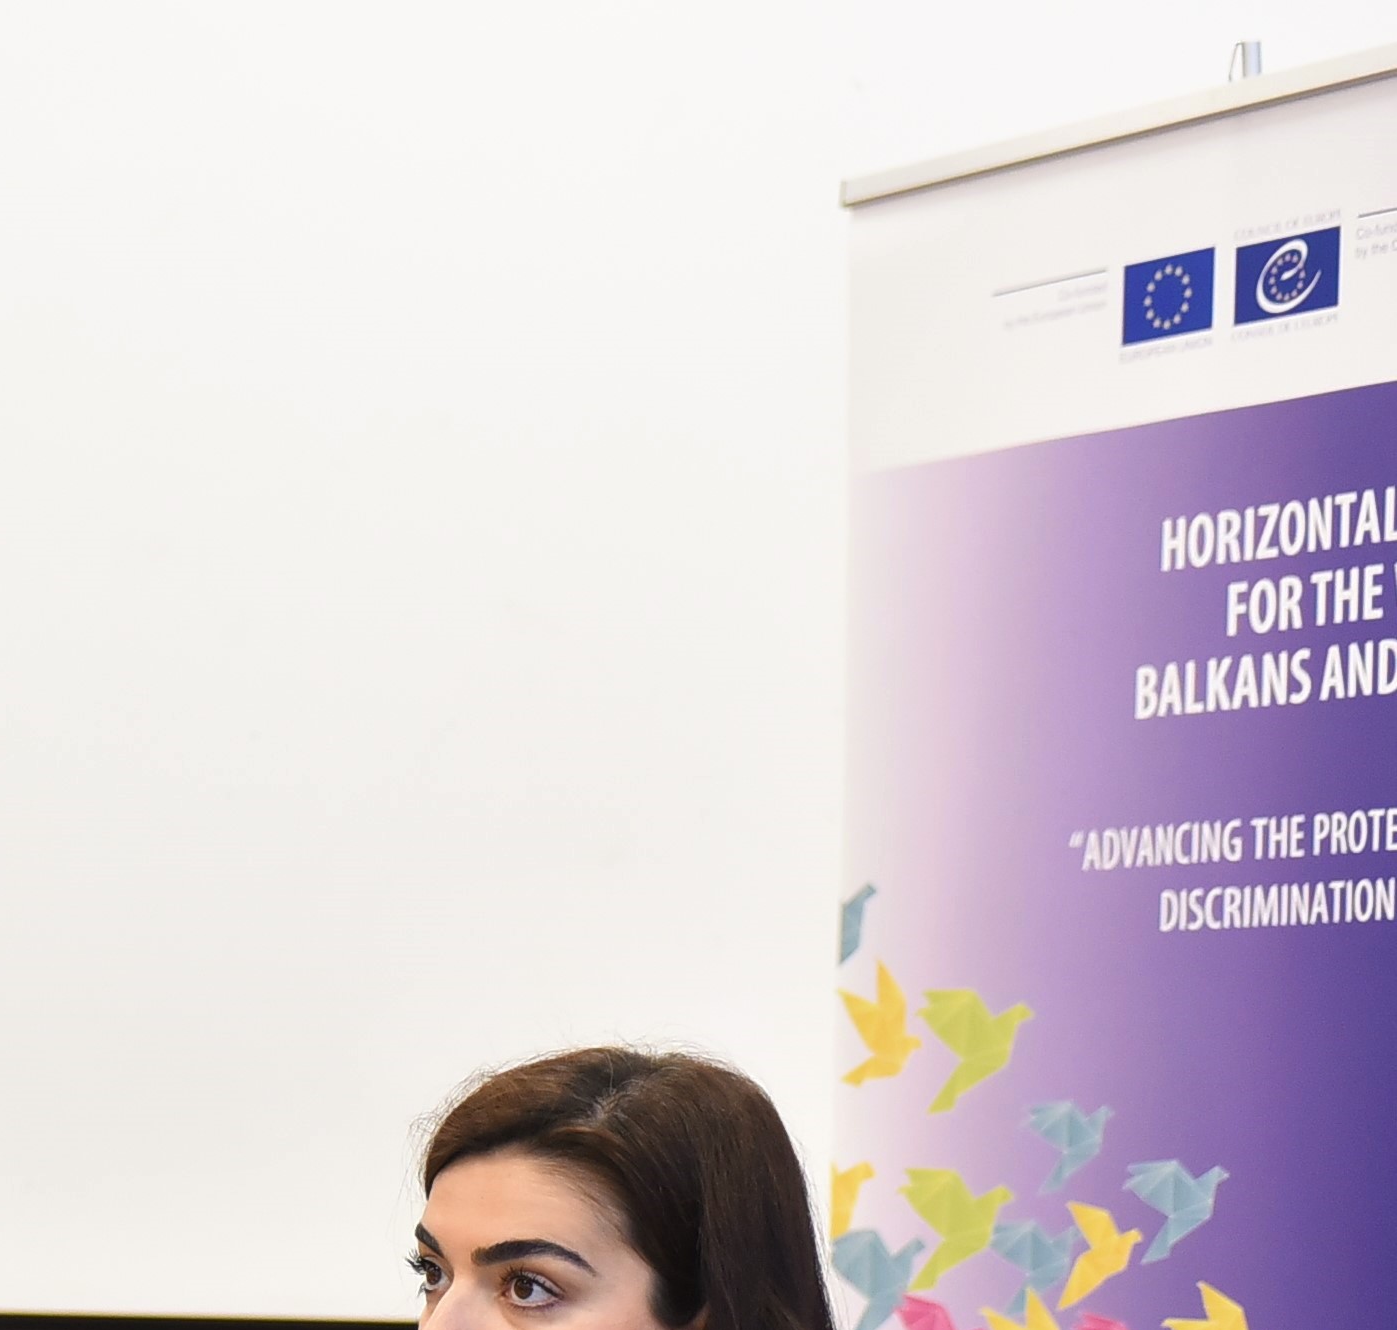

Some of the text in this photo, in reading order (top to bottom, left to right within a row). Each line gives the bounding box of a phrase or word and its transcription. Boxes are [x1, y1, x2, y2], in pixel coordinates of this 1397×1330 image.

[1160, 485, 1397, 572] HORIZONTAL
[1226, 575, 1303, 636] FOR
[1310, 563, 1385, 627] THE
[1134, 638, 1397, 720] BALKANS AND
[1250, 813, 1306, 861] THE
[1312, 807, 1397, 857] PROTE
[1159, 876, 1395, 933] DISCRIMINATION
